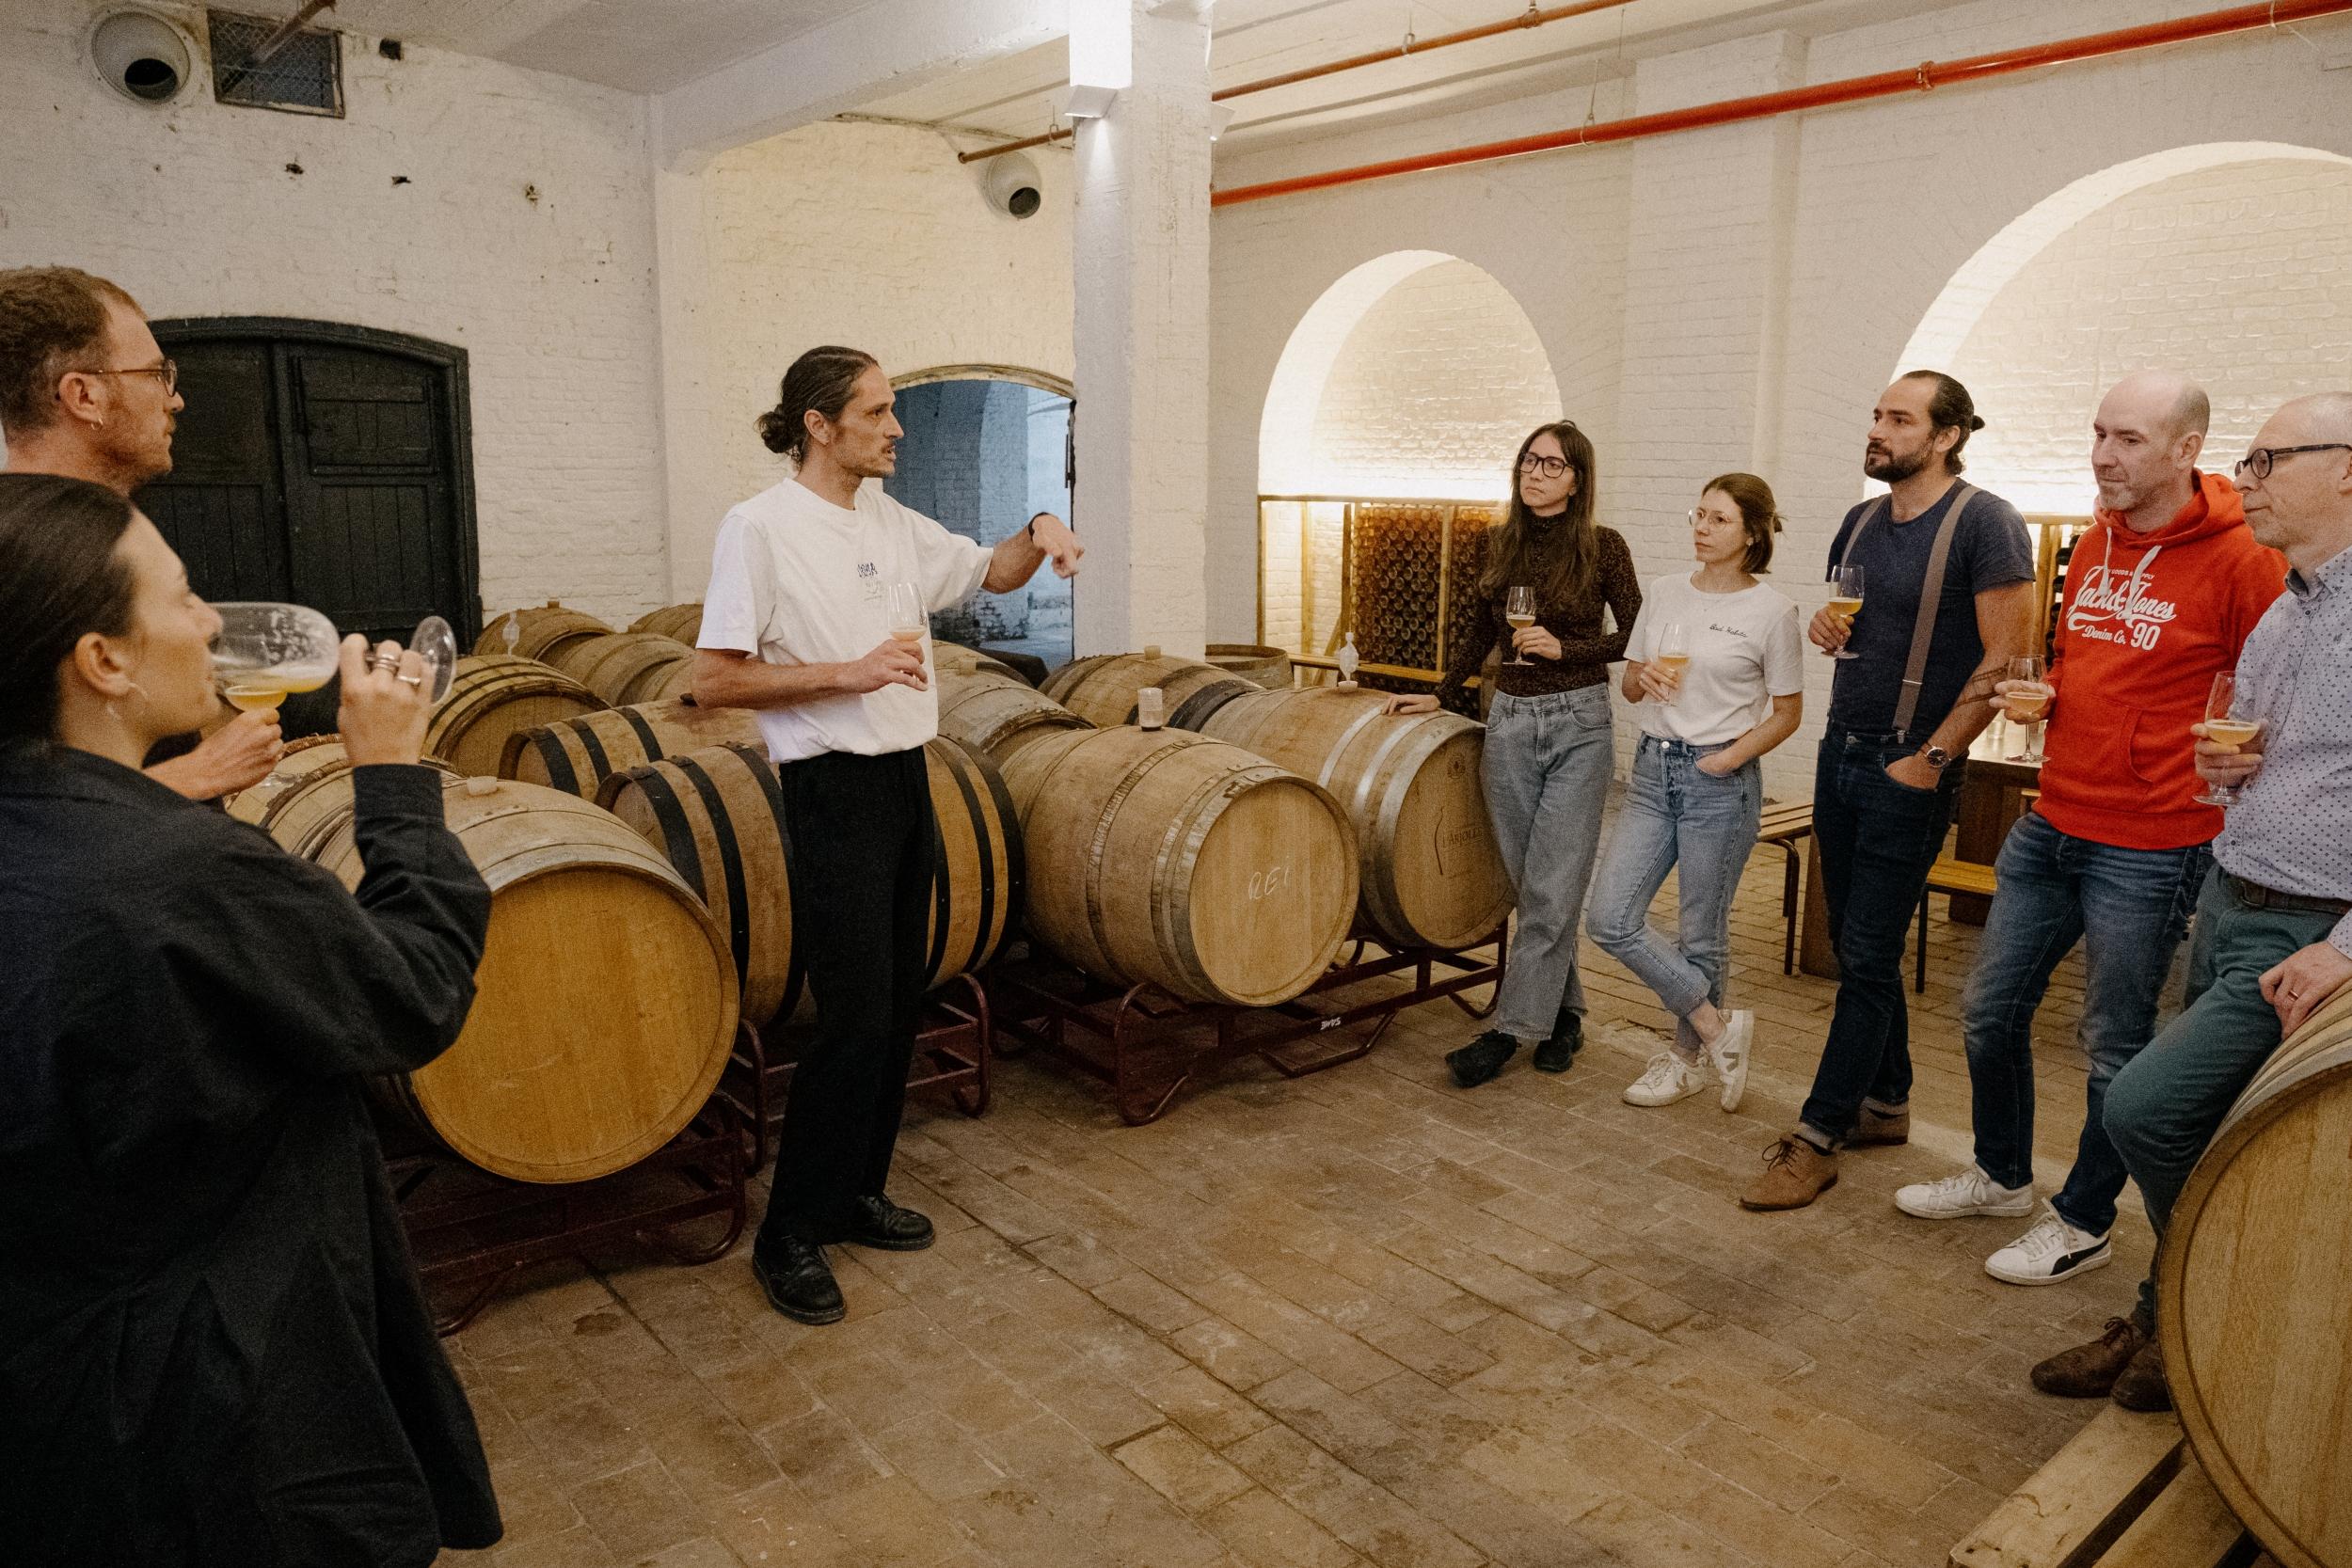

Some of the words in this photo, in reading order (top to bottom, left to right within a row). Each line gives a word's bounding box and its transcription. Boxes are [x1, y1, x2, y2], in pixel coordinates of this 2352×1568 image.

[2082, 626, 2113, 641] Denim
[2114, 629, 2127, 644] Co.
[2130, 622, 2161, 651] 90
